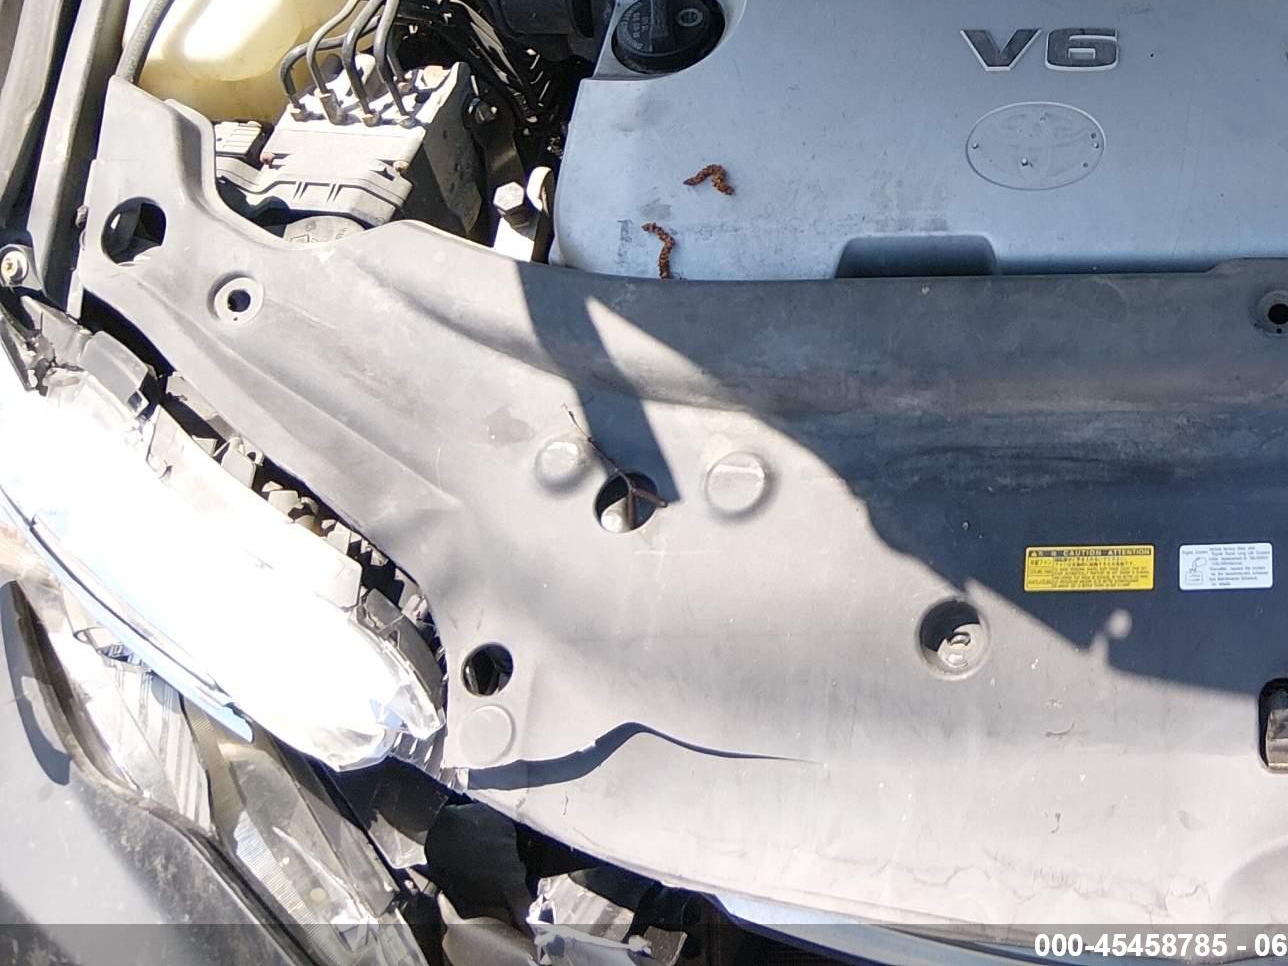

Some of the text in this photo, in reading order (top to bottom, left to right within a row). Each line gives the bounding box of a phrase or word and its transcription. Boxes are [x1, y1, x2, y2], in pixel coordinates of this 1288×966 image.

[960, 28, 1119, 71] V6
[1063, 549, 1102, 557] CAUTION
[1107, 548, 1150, 556] ATTENTION
